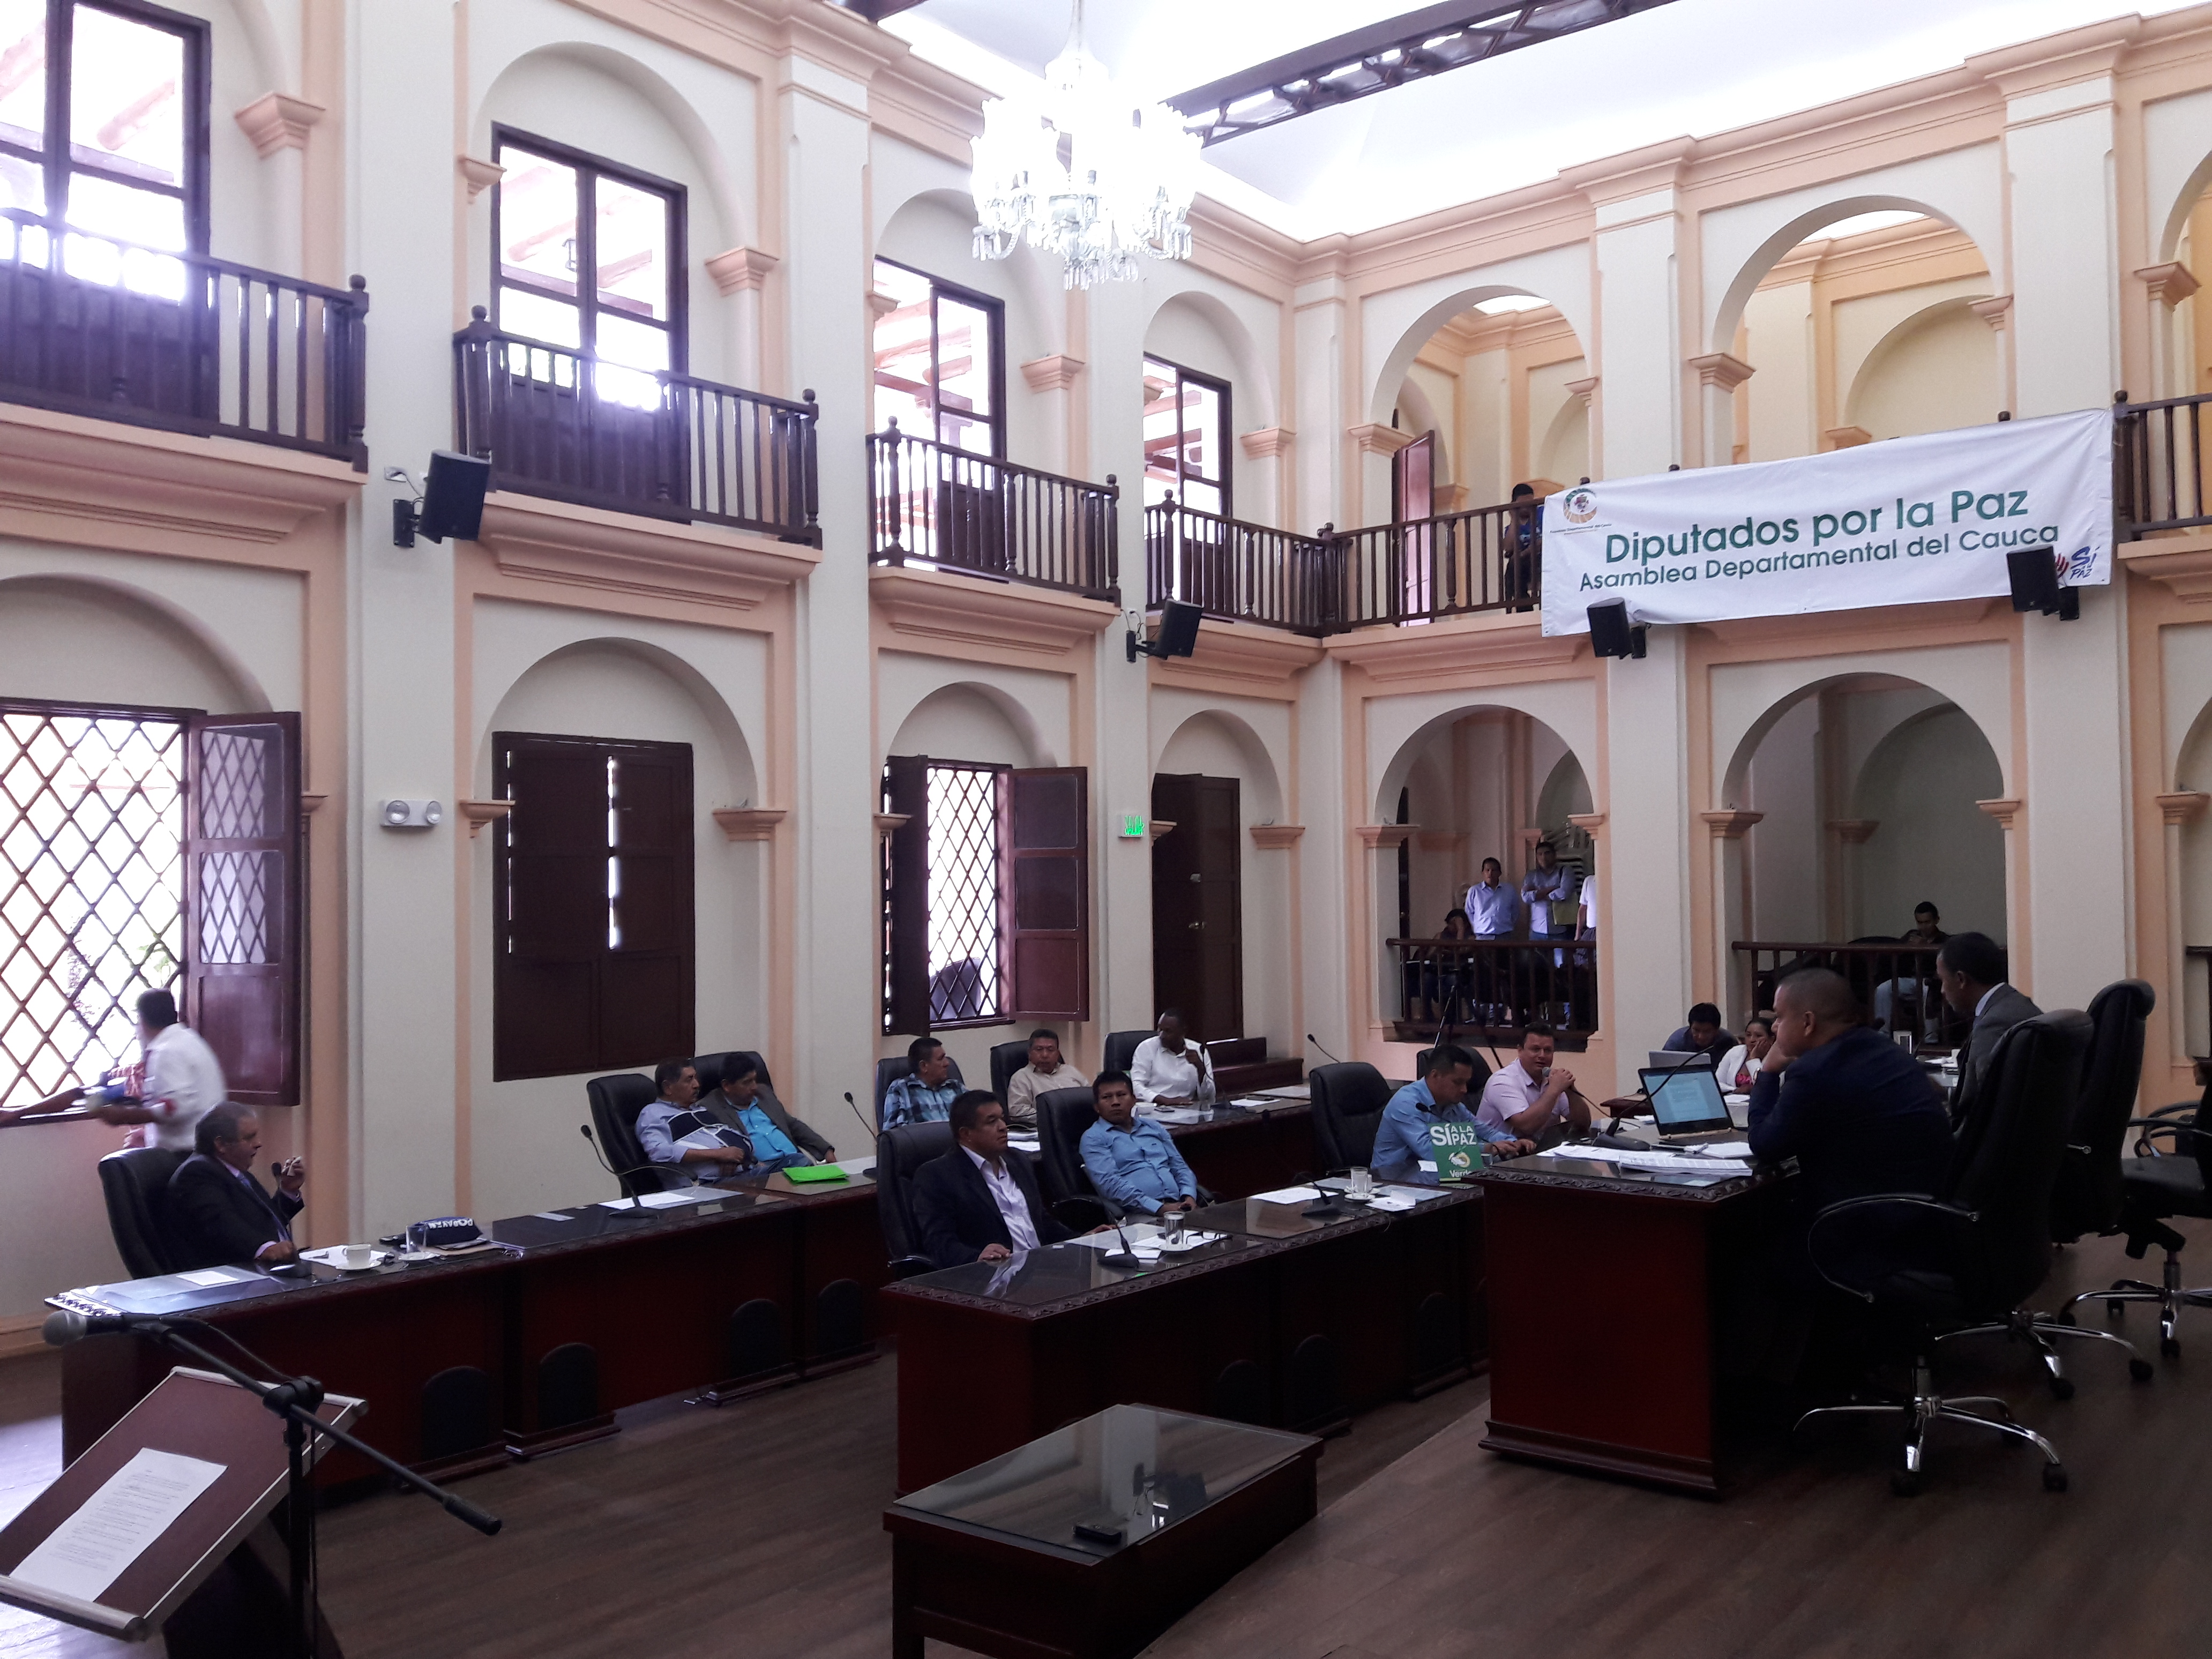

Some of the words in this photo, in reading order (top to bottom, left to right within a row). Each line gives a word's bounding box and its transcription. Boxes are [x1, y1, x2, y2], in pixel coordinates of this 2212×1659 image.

[1606, 517, 1799, 566] Diputados
[1813, 507, 1883, 547] por
[1896, 497, 1934, 530] la
[1952, 490, 2029, 524] Paz
[1579, 565, 1697, 592] Asamblea
[1706, 539, 1897, 580] Departamental
[1907, 533, 1949, 557] del
[1959, 525, 2058, 551] Cauca
[1430, 1123, 1453, 1146] SÍ
[1452, 1132, 1477, 1146] PAZ
